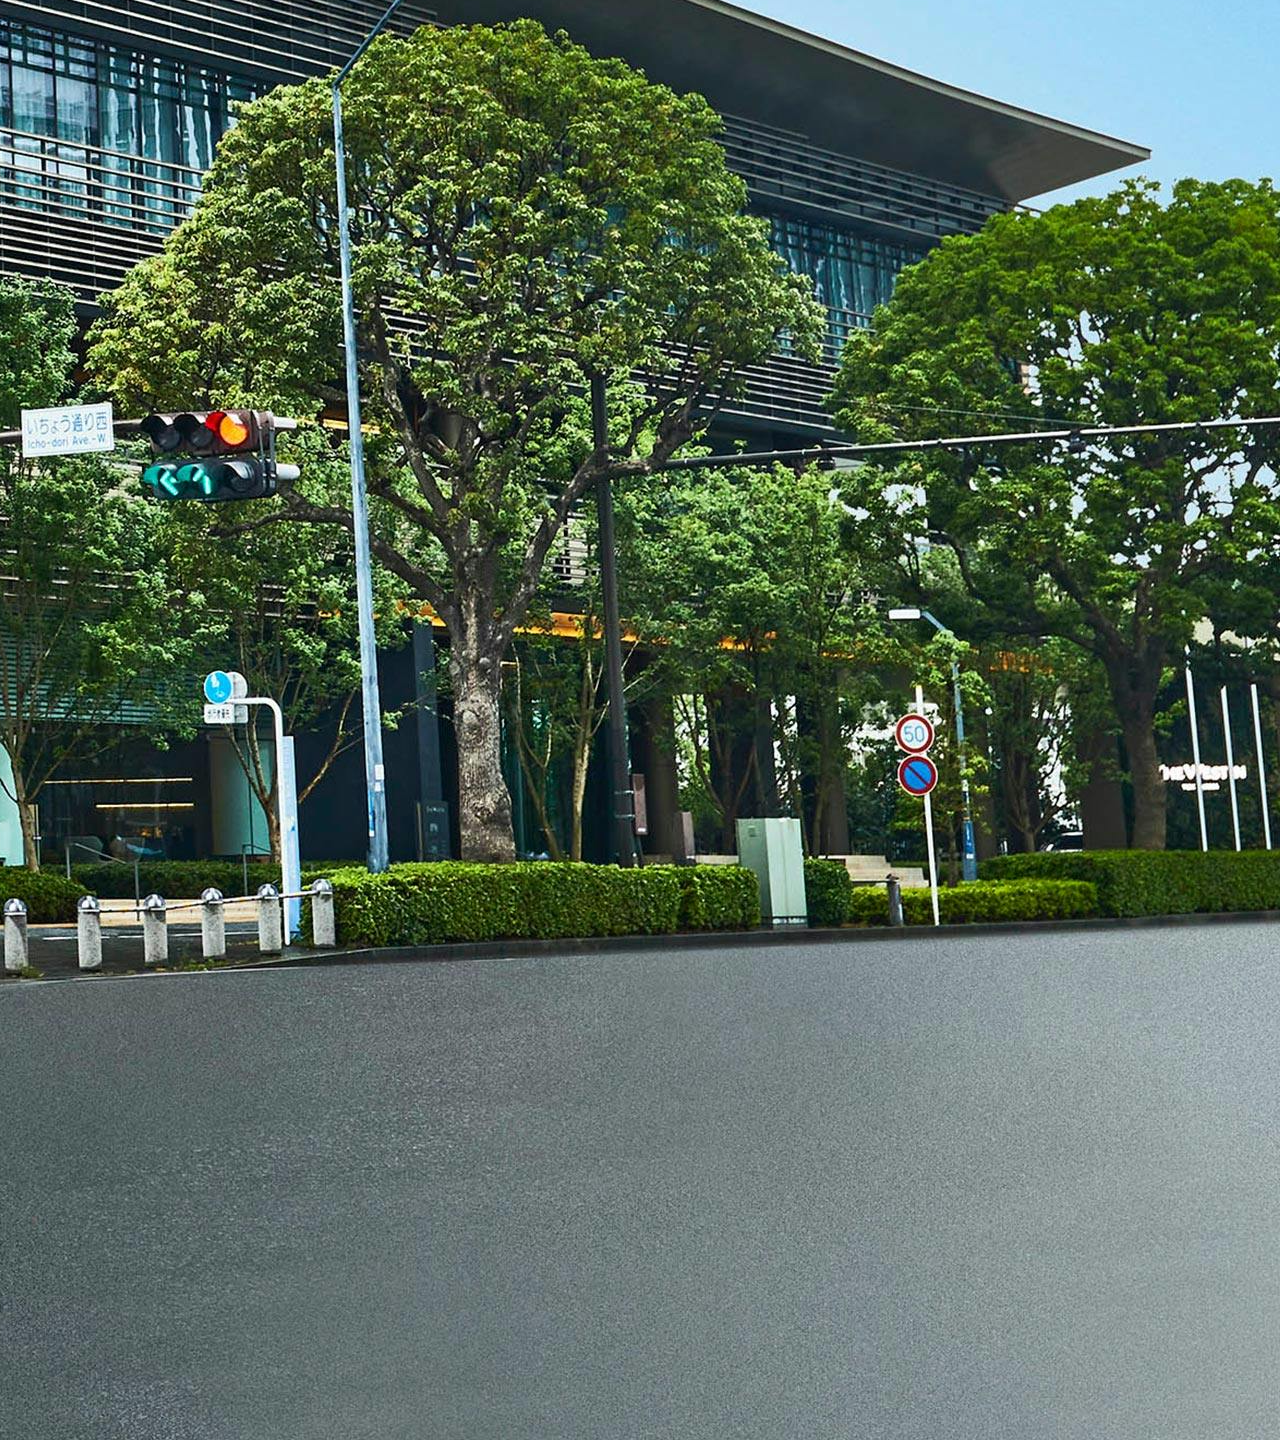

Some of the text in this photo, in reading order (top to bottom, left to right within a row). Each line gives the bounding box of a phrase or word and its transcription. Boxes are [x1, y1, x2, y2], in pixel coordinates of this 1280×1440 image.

[26, 411, 107, 435] いちょう通り西
[27, 436, 68, 449] Icho-dori
[904, 725, 925, 743] 50
